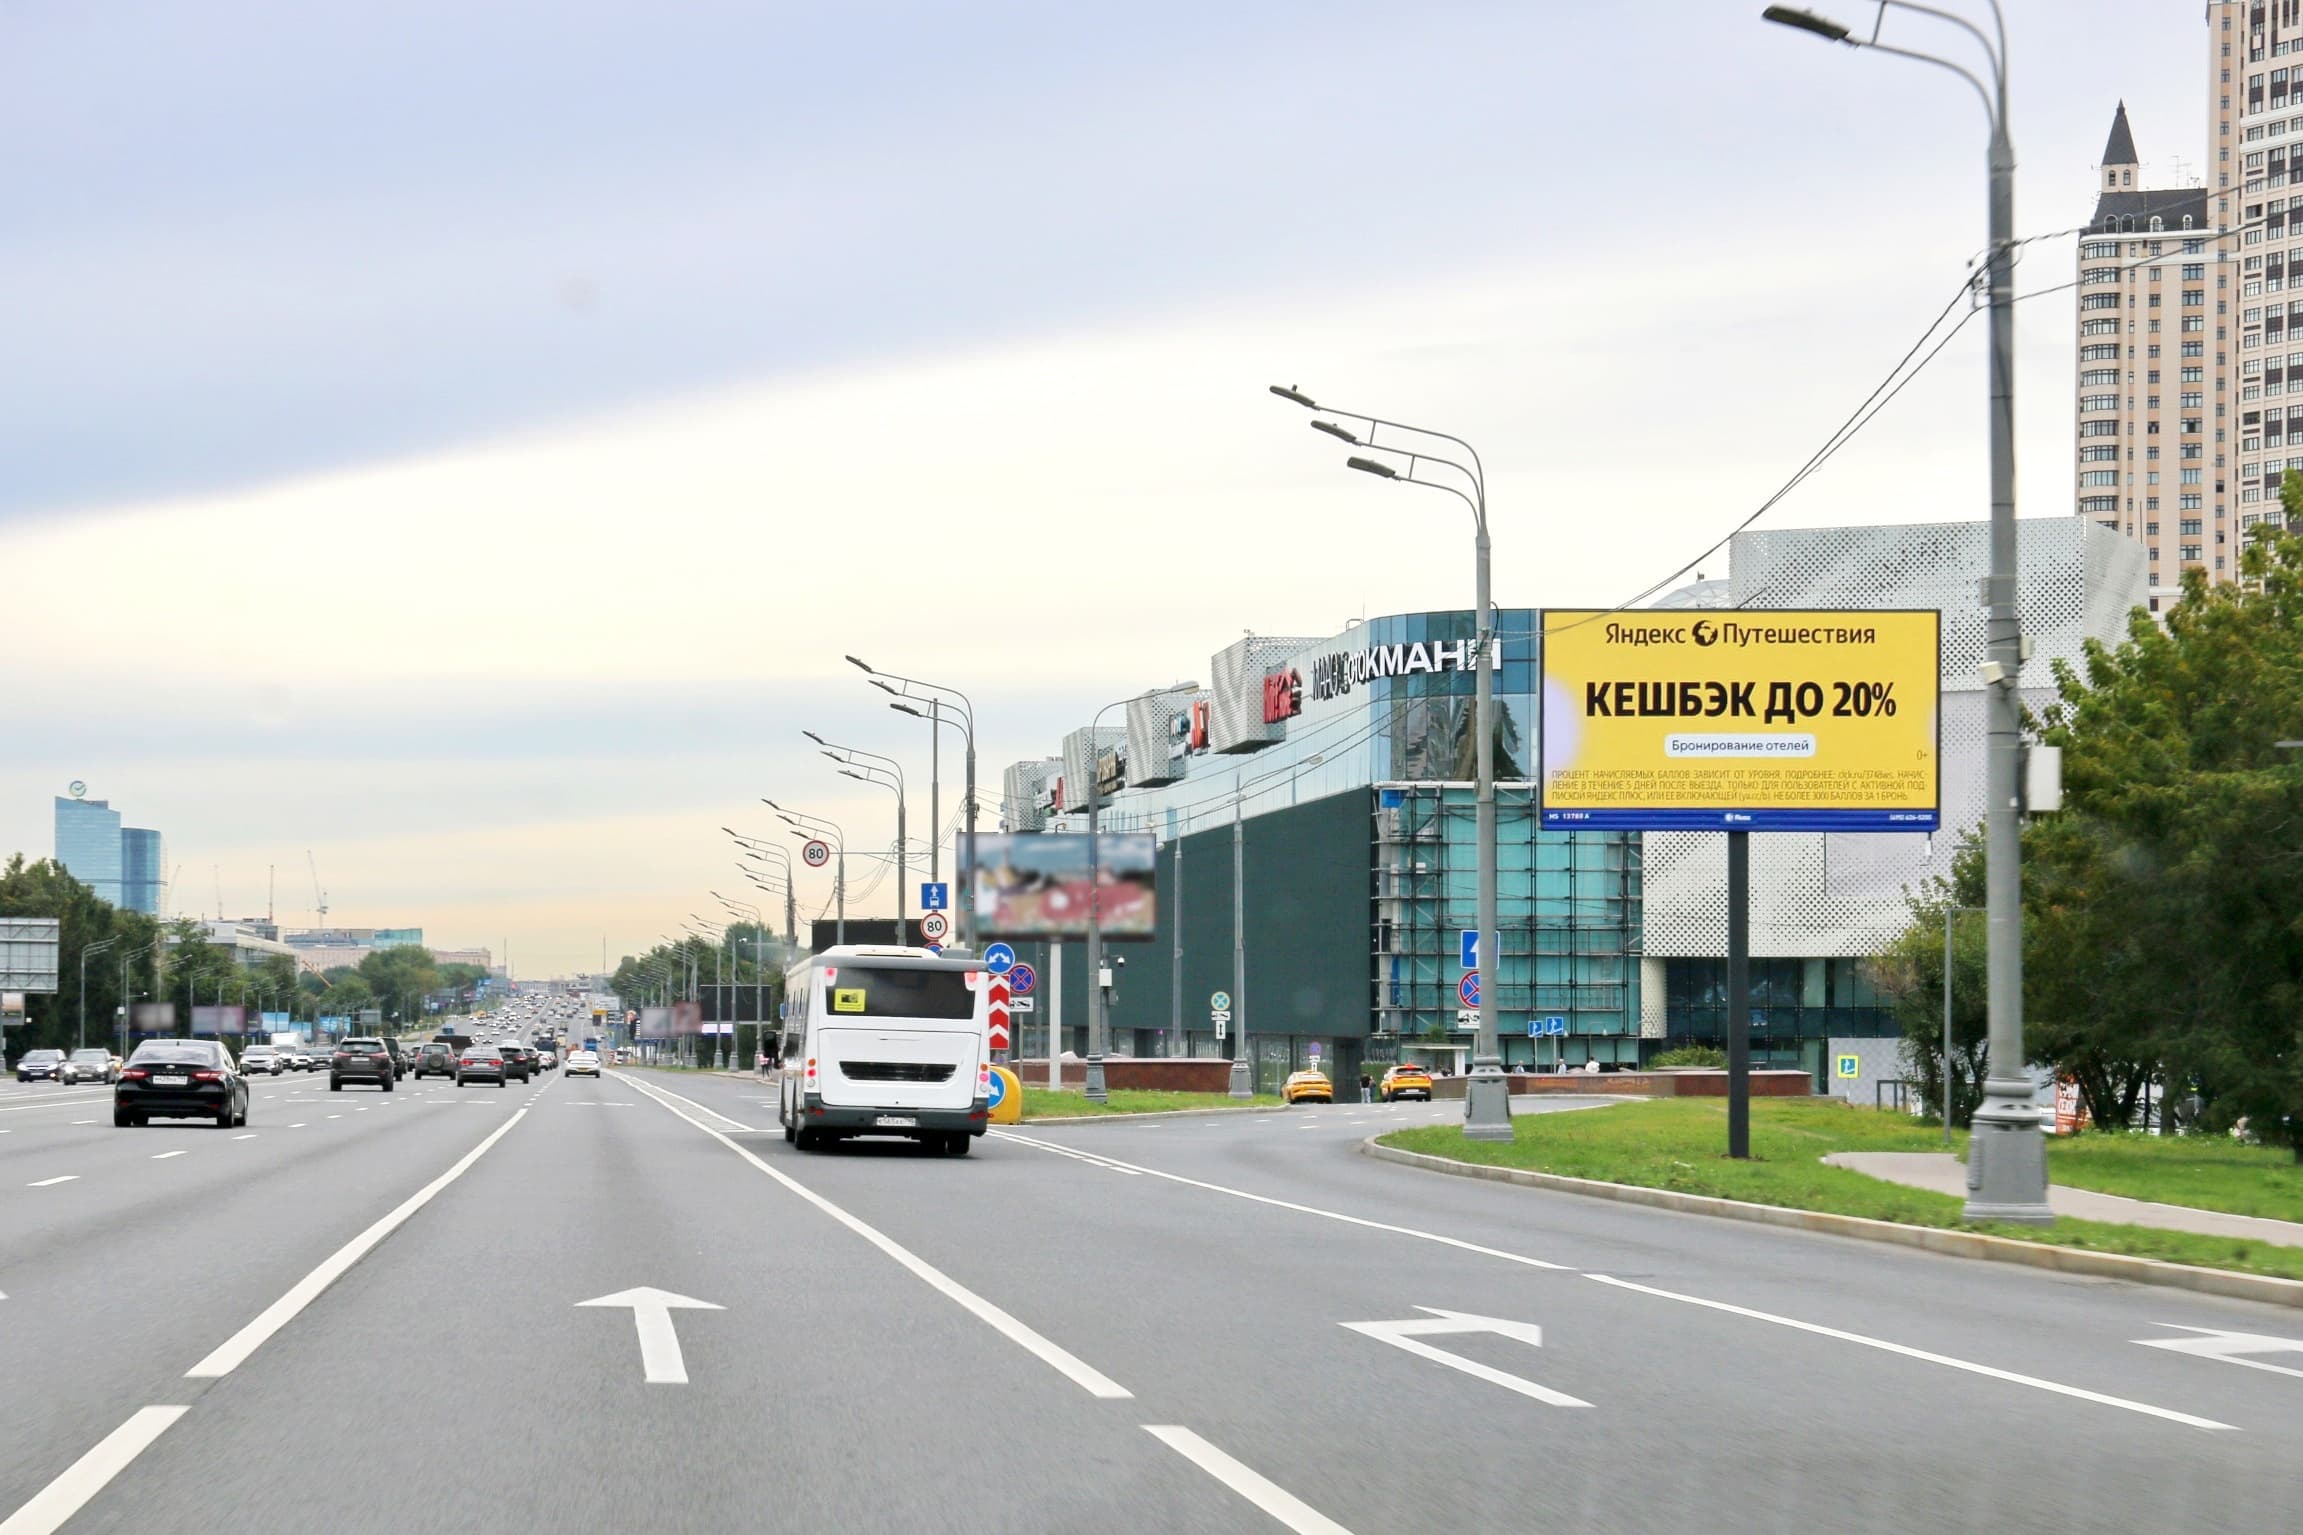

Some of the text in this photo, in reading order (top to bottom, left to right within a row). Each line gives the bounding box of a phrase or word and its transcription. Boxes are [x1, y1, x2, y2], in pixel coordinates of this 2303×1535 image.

[1606, 623, 1876, 647] Яндекс Путешествия
[1586, 681, 1897, 724] КЕШБЭК ДО 20%
[1671, 739, 1810, 753] Бронирование отелей
[1916, 749, 1928, 761] 0+
[1552, 770, 1590, 780] ПРОЦЕНТ
[1593, 770, 1655, 779] НАЧИСЛЯЕМЫХ
[1657, 770, 1690, 779] БАЛЛОВ
[1693, 770, 1730, 779] ЗАВИСИТ
[1734, 770, 1744, 779] ОТ
[1552, 780, 1579, 790] ЛЕНИЕ
[1588, 780, 1625, 790] ТЕЧЕНИЕ
[1634, 780, 1657, 790] ДНЕЙ
[1660, 780, 1686, 790] ПОСЛЕ
[1728, 780, 1758, 790] ТОЛЬКО
[1761, 780, 1779, 790] ДЛЯ
[1781, 780, 1850, 790] ПОЛЬЗОВАТЕЛЕЙ
[1860, 780, 1905, 790] АКТИВНОЙ
[1647, 791, 1665, 800] ИЛИ
[1830, 791, 1863, 800] БАЛЛОВ
[808, 848, 824, 859] 80
[927, 920, 942, 932] 80
